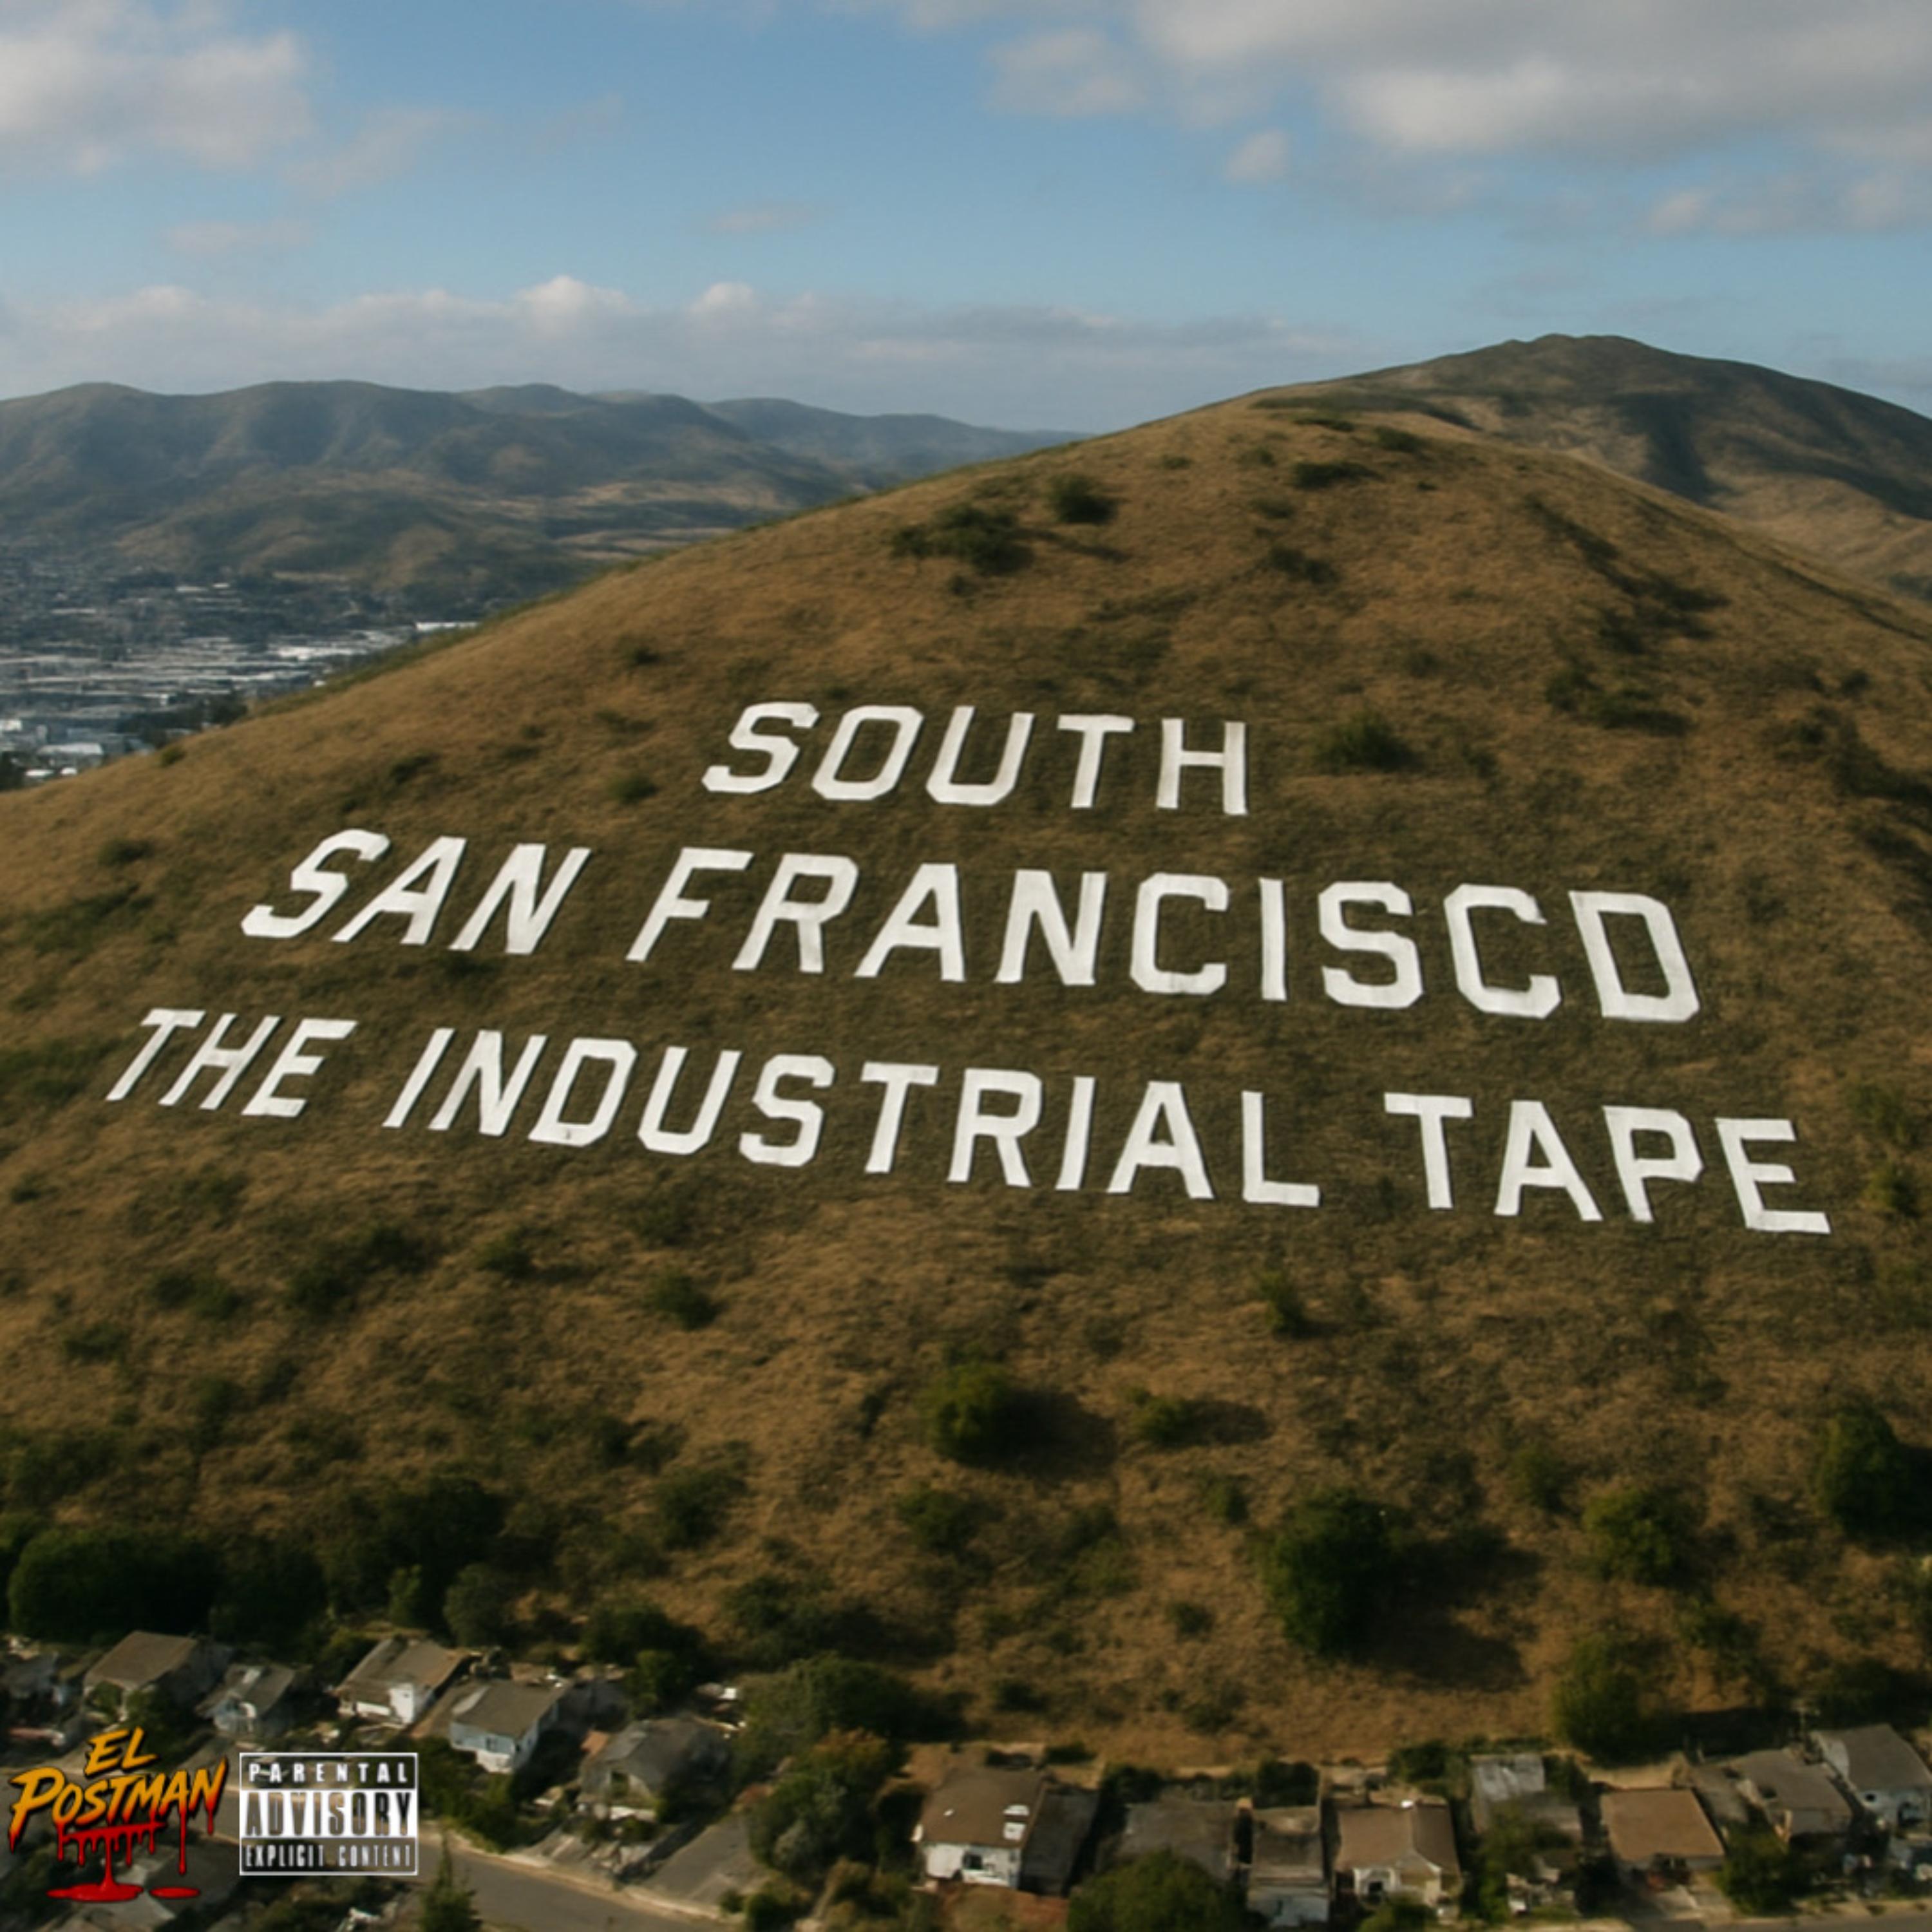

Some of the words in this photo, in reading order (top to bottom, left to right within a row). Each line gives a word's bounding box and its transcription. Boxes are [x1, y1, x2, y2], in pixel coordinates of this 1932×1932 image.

[701, 701, 1249, 817] SOUTH
[240, 828, 592, 956] SAN
[106, 1007, 357, 1119] THE
[381, 1027, 1321, 1208] INDUSTRIAL
[1383, 1092, 1832, 1235] TAPE
